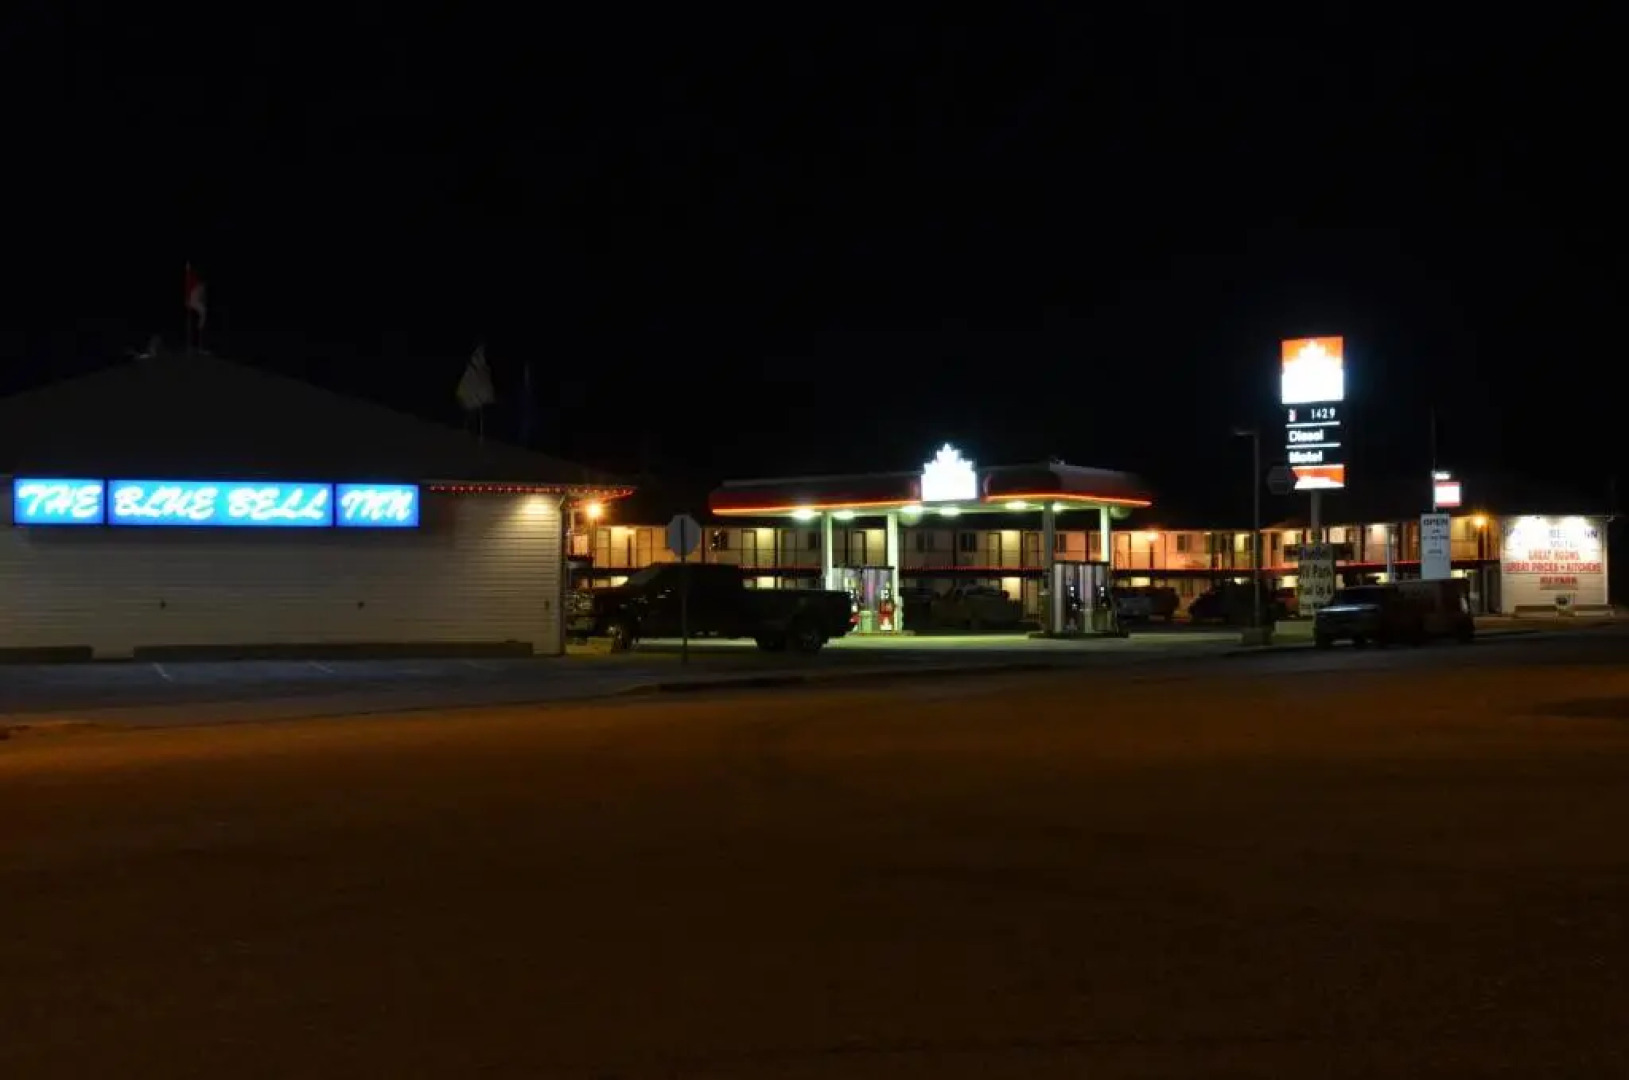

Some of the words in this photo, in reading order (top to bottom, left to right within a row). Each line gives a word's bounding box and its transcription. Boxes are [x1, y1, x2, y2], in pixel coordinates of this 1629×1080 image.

[1289, 429, 1324, 442] Diesel
[17, 484, 102, 519] THE
[114, 486, 220, 520] BLUE
[228, 487, 328, 520] BELL
[341, 488, 413, 521] INN
[1423, 518, 1448, 526] OPEN
